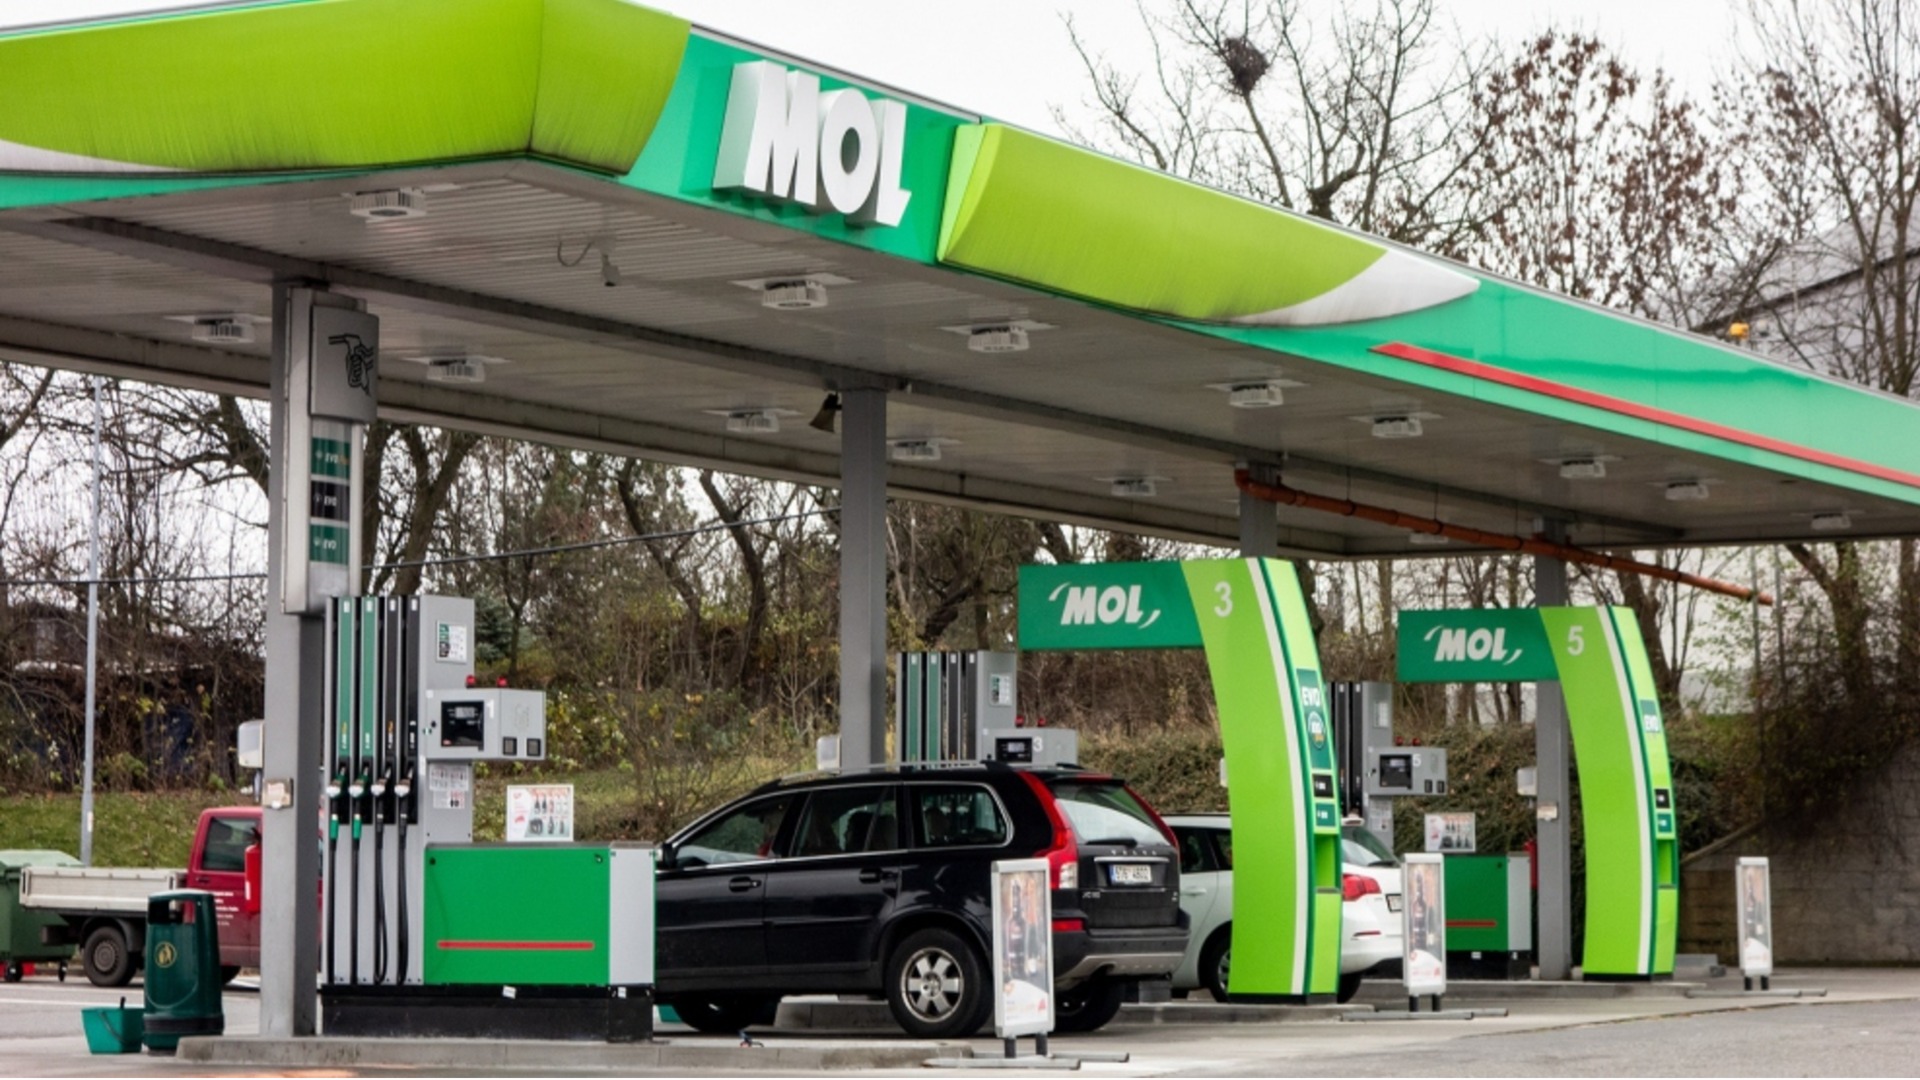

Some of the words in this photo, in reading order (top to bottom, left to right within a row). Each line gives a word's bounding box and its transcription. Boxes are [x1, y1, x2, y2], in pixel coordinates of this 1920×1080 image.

[713, 60, 912, 228] MOL
[1060, 585, 1143, 625] MOL
[1214, 581, 1233, 617] 3
[1434, 628, 1508, 662] MOL
[1567, 626, 1585, 656] 5
[486, 700, 495, 718] 1
[1302, 687, 1321, 706] EVO
[1032, 736, 1043, 752] 3
[1412, 753, 1422, 767] 5
